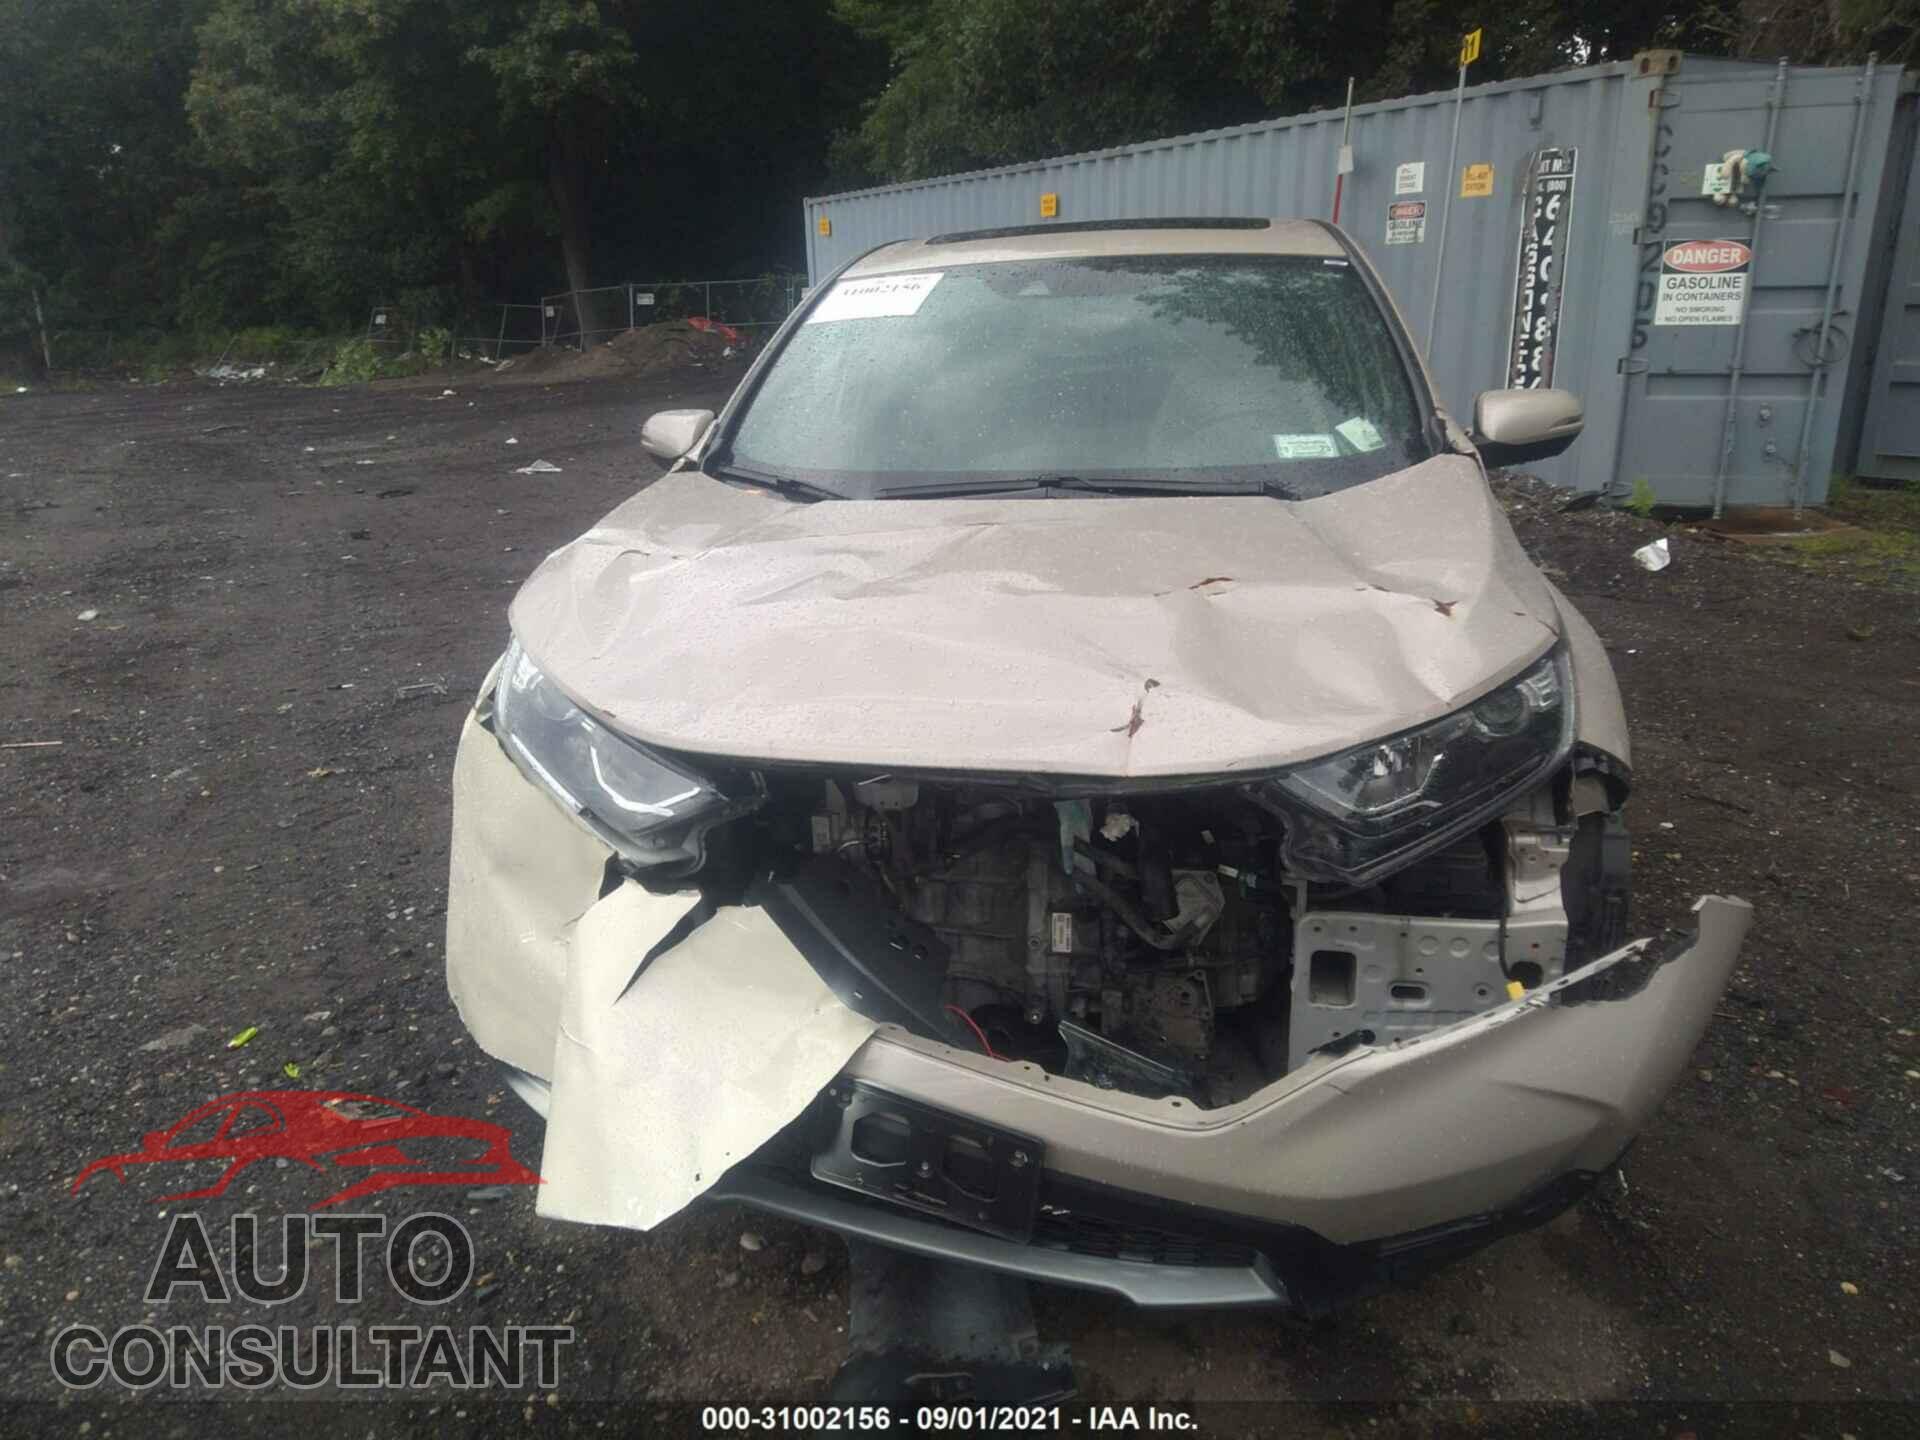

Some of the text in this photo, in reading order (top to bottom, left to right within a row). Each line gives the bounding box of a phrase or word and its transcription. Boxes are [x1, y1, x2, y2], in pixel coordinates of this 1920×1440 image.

[1672, 248, 1741, 264] DANGER
[1666, 276, 1742, 290] GASOLINE
[1663, 292, 1741, 301] IN CONTAINERS
[1690, 305, 1726, 313] SMOKING
